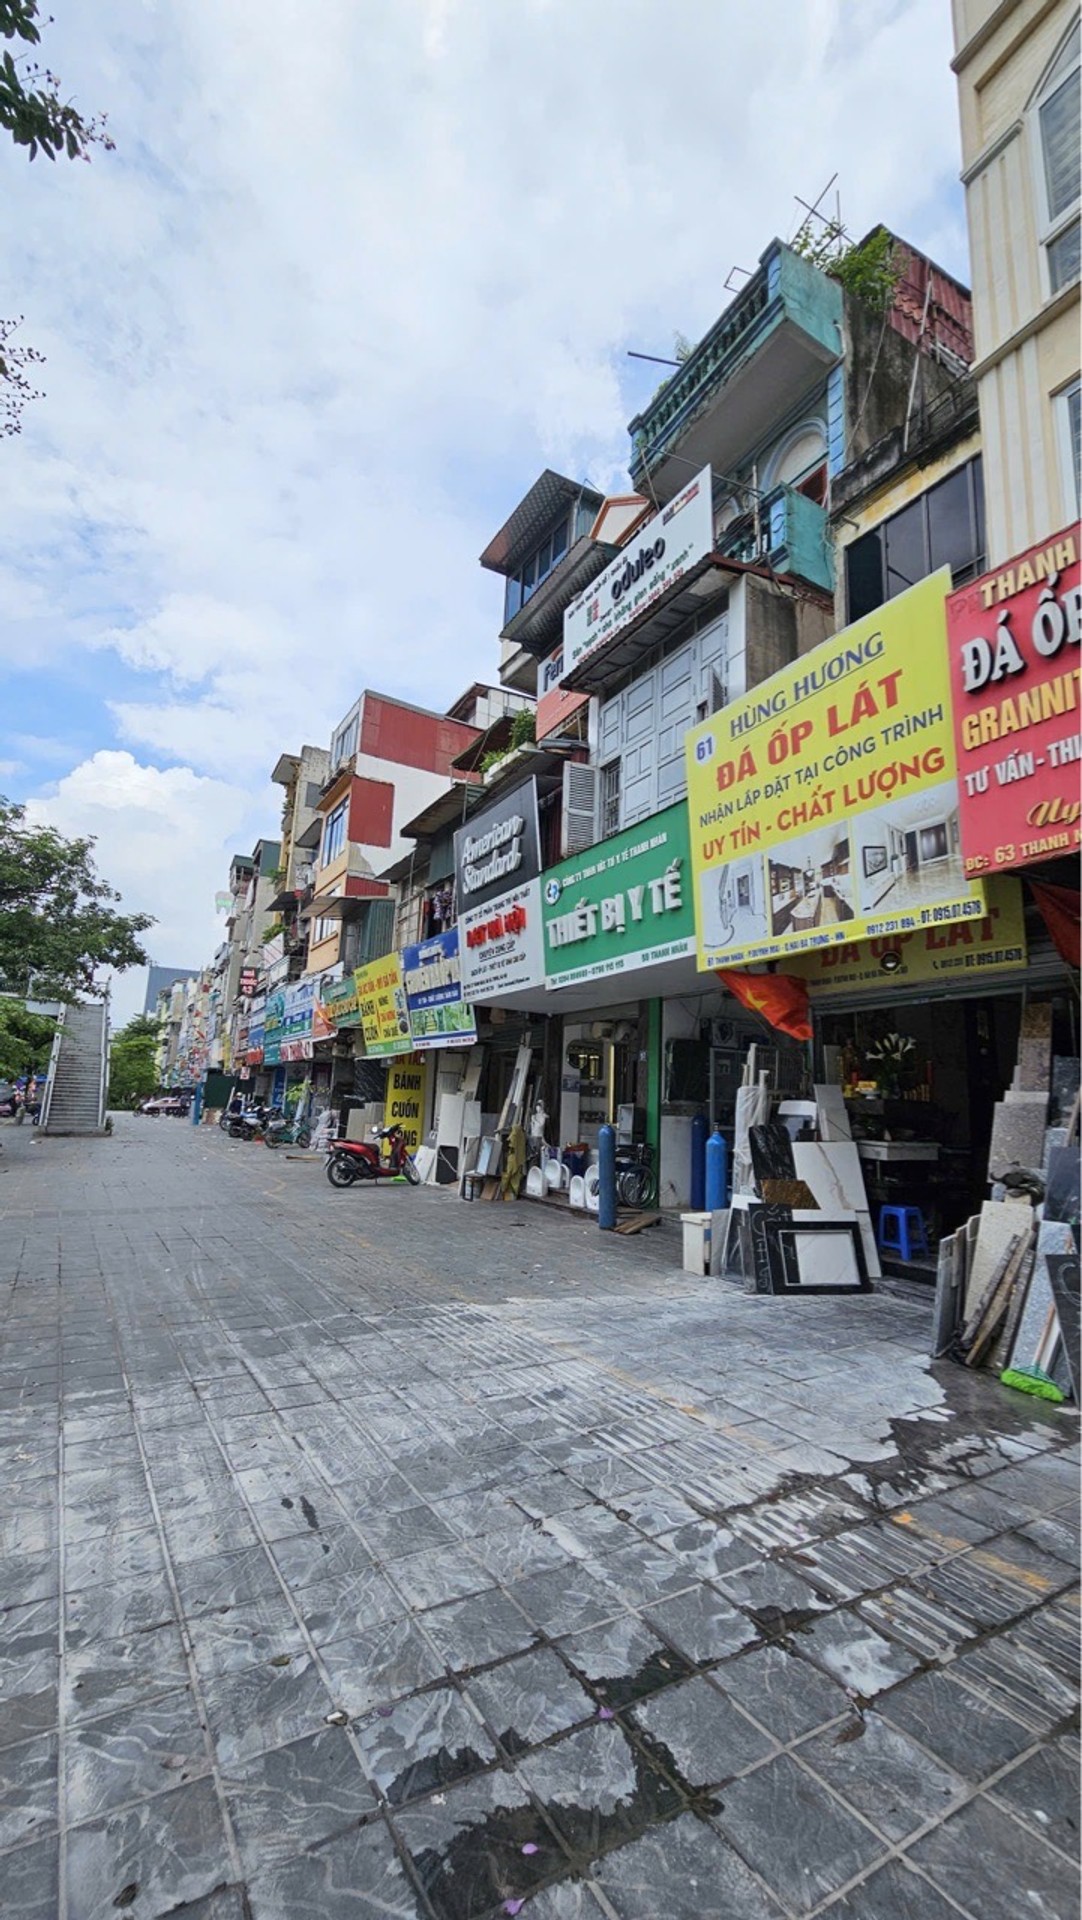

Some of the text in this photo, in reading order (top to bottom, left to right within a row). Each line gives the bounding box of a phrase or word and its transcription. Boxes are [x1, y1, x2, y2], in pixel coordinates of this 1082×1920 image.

[980, 536, 1076, 610] THANH
[730, 631, 884, 737] HÙNG HƯƠNG
[961, 609, 1025, 692] ĐÁ
[696, 735, 713, 760] 61
[700, 803, 733, 827] NHẬN
[765, 774, 790, 799] ĐẶT
[795, 762, 819, 785] TẠI
[823, 745, 876, 772] CÔNG
[880, 704, 944, 745] TRÌNH
[717, 669, 903, 791] ĐÁ ỐP LÁT
[965, 765, 989, 796] TƯ
[994, 748, 1035, 785] VẤN
[1047, 734, 1081, 768] THI
[703, 836, 725, 861] UY
[730, 820, 760, 850] TÍN
[777, 784, 836, 832] CHẤT
[844, 746, 946, 807] LƯỢNG
[460, 814, 524, 868] American
[462, 836, 522, 895] Standard
[995, 844, 1015, 863] 63
[1021, 832, 1070, 857] THANH
[546, 857, 683, 948] THIẾT BỊ Y TẾ
[393, 1070, 422, 1091] BÁNH
